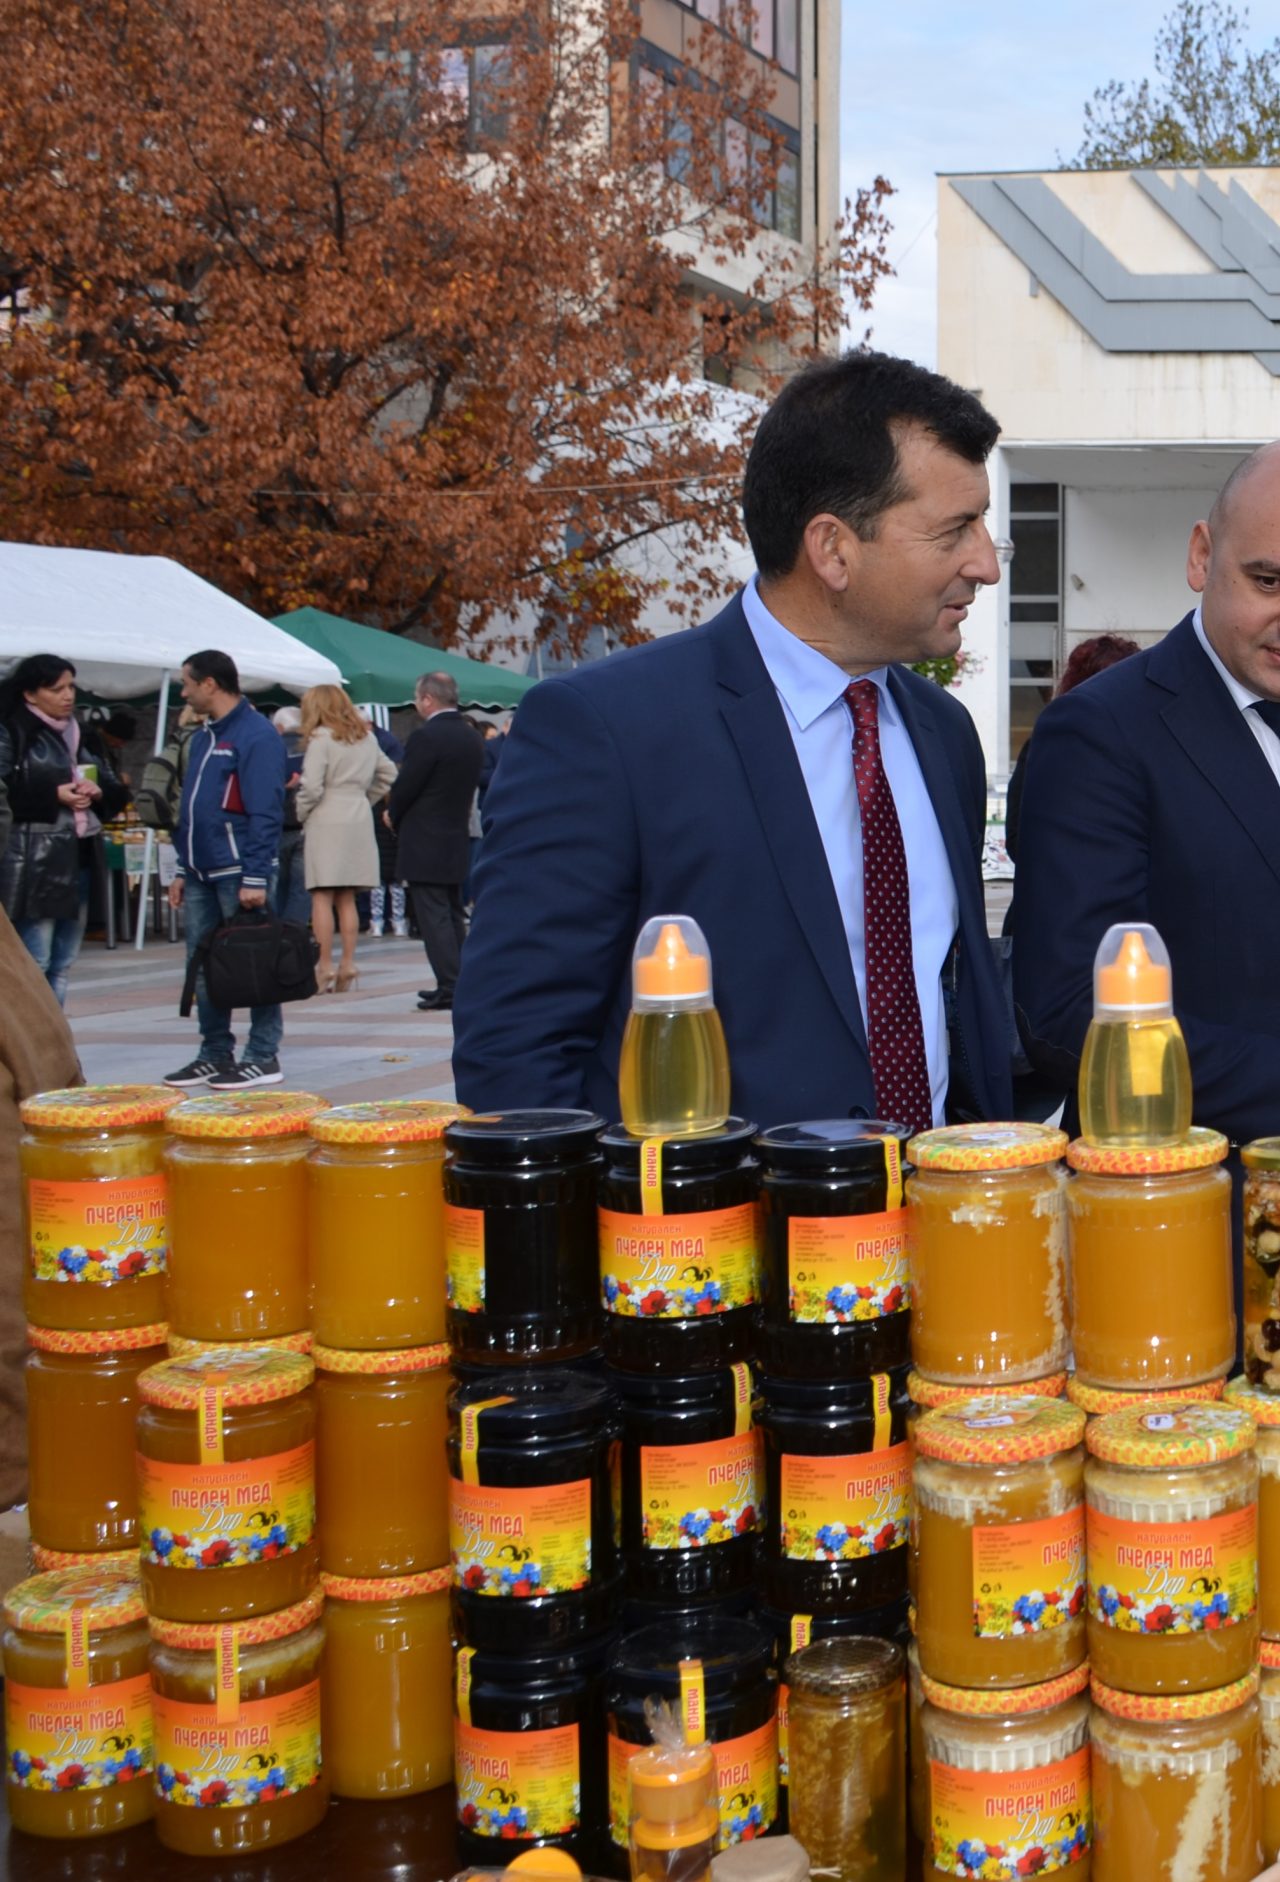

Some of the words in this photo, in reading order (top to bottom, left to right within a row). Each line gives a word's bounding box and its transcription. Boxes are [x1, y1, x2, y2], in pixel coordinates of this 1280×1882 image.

[646, 1146, 657, 1187] манов
[86, 1202, 145, 1225] пчелен
[616, 1237, 664, 1258] пчелен
[671, 1237, 705, 1258] мед
[204, 1387, 218, 1450] ориандър
[172, 1487, 229, 1508] пчелен
[236, 1482, 272, 1503] мед
[490, 1514, 524, 1537] мед
[1117, 1546, 1173, 1569] пчелен
[1180, 1546, 1214, 1569] мед
[71, 1608, 84, 1669] ориандър
[796, 1622, 806, 1650] ман
[28, 1711, 84, 1733] пчелен
[90, 1707, 126, 1730] мед
[688, 1688, 699, 1730] манов
[174, 1726, 228, 1748] пчелен
[234, 1725, 271, 1747] мед
[480, 1757, 510, 1780] мед
[719, 1762, 750, 1788] мед
[986, 1793, 1045, 1817] пчелен
[1050, 1781, 1077, 1809] мед
